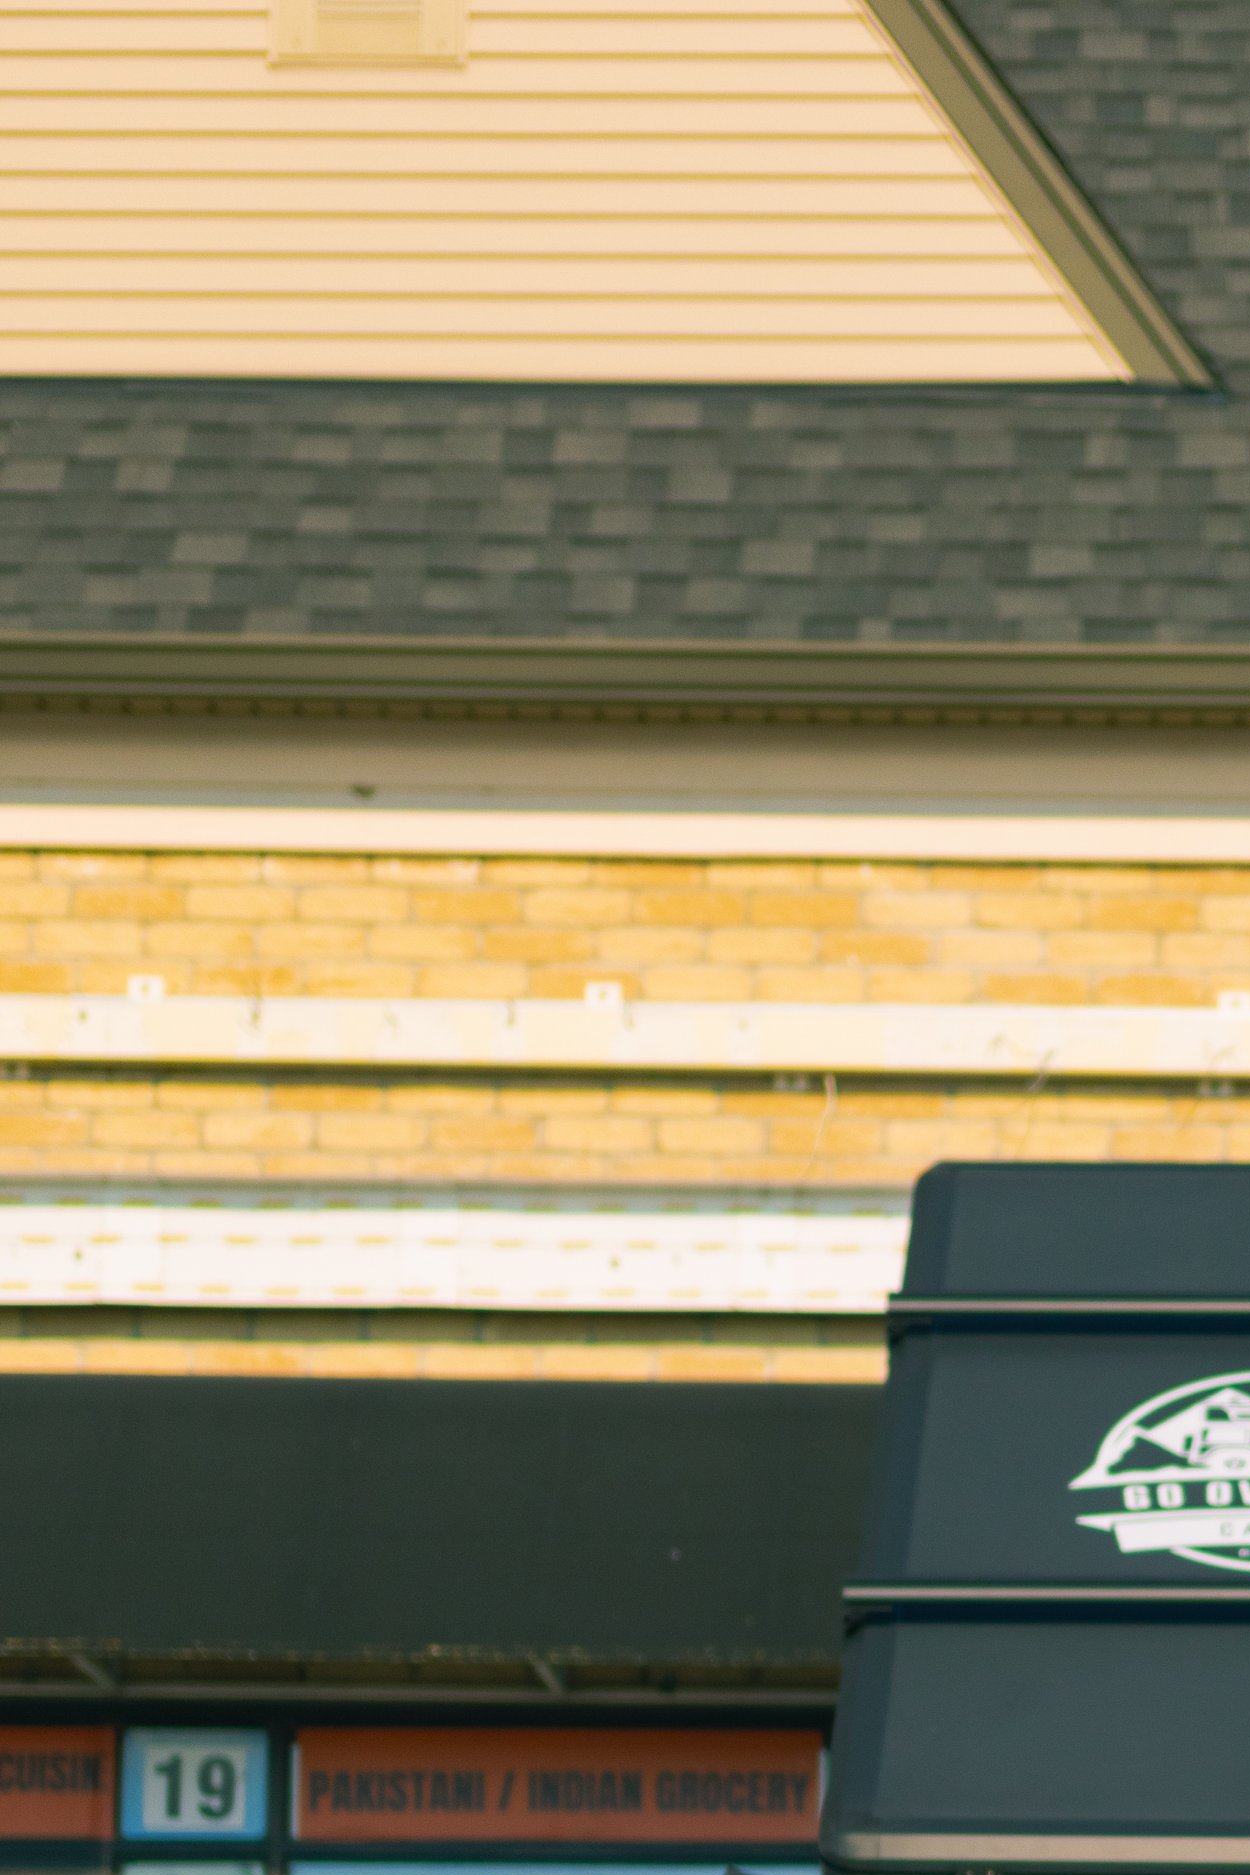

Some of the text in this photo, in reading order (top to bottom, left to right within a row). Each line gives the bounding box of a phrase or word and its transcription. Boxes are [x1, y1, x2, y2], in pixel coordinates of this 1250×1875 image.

[1122, 1484, 1185, 1511] GO
[153, 1752, 238, 1822] 19
[307, 1770, 486, 1812] PAKISTANI
[527, 1771, 643, 1812] INDIAN
[656, 1772, 811, 1814] GROCERY
